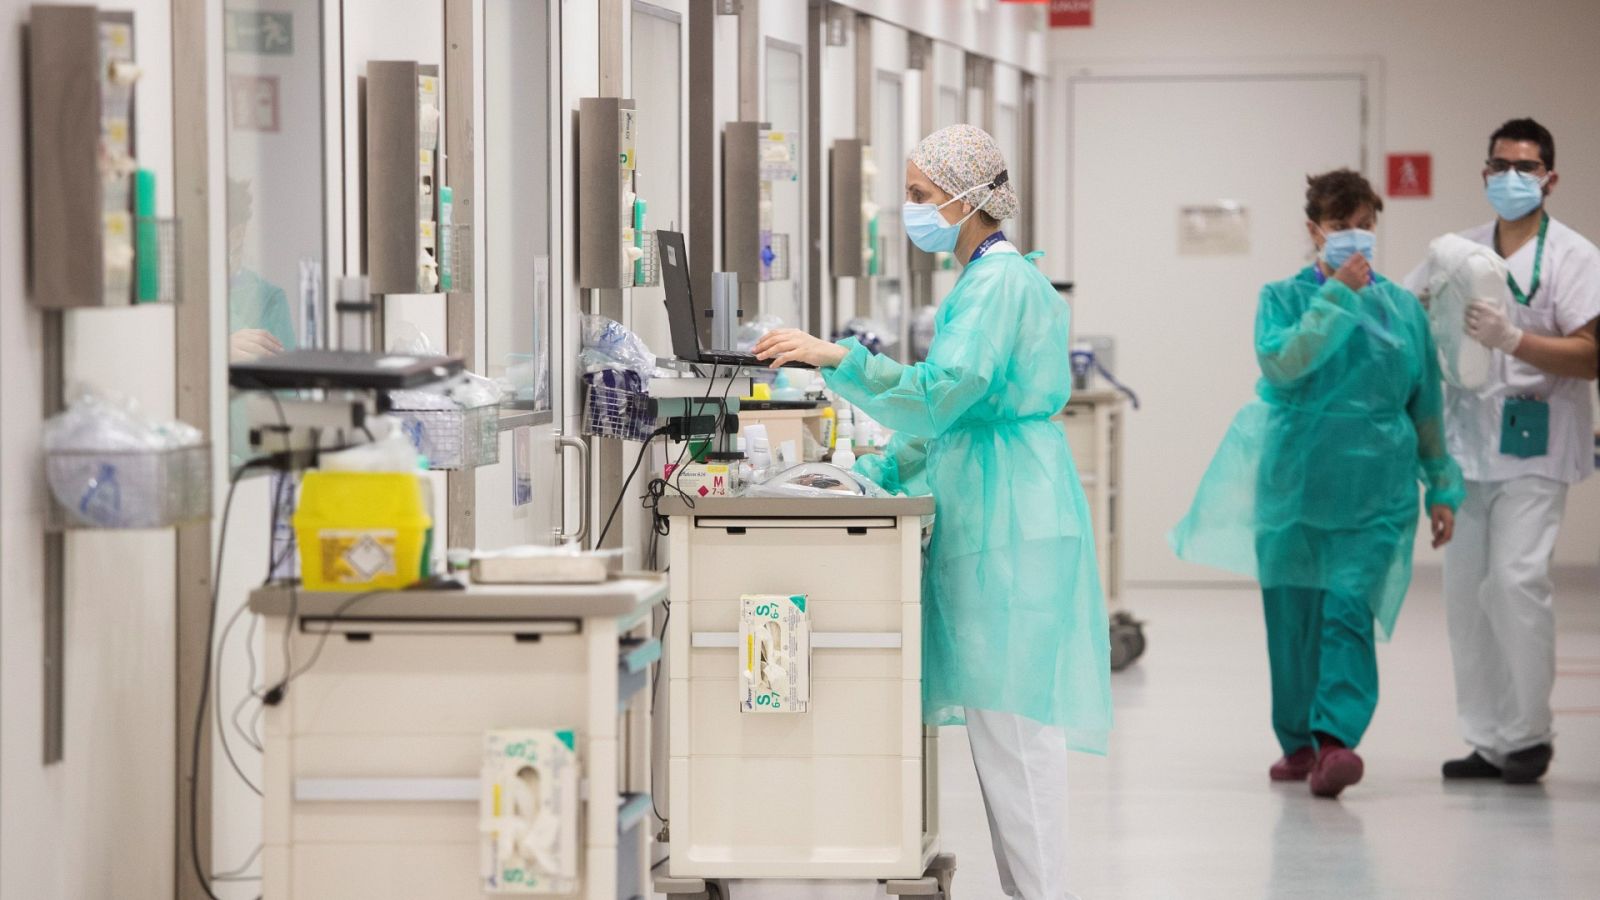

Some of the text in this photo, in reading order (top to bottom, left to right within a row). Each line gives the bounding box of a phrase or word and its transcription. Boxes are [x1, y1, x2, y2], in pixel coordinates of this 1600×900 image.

[713, 475, 724, 488] M
[756, 605, 770, 616] S
[770, 602, 779, 619] 6-7
[757, 694, 771, 705] S
[771, 691, 781, 708] 6-7
